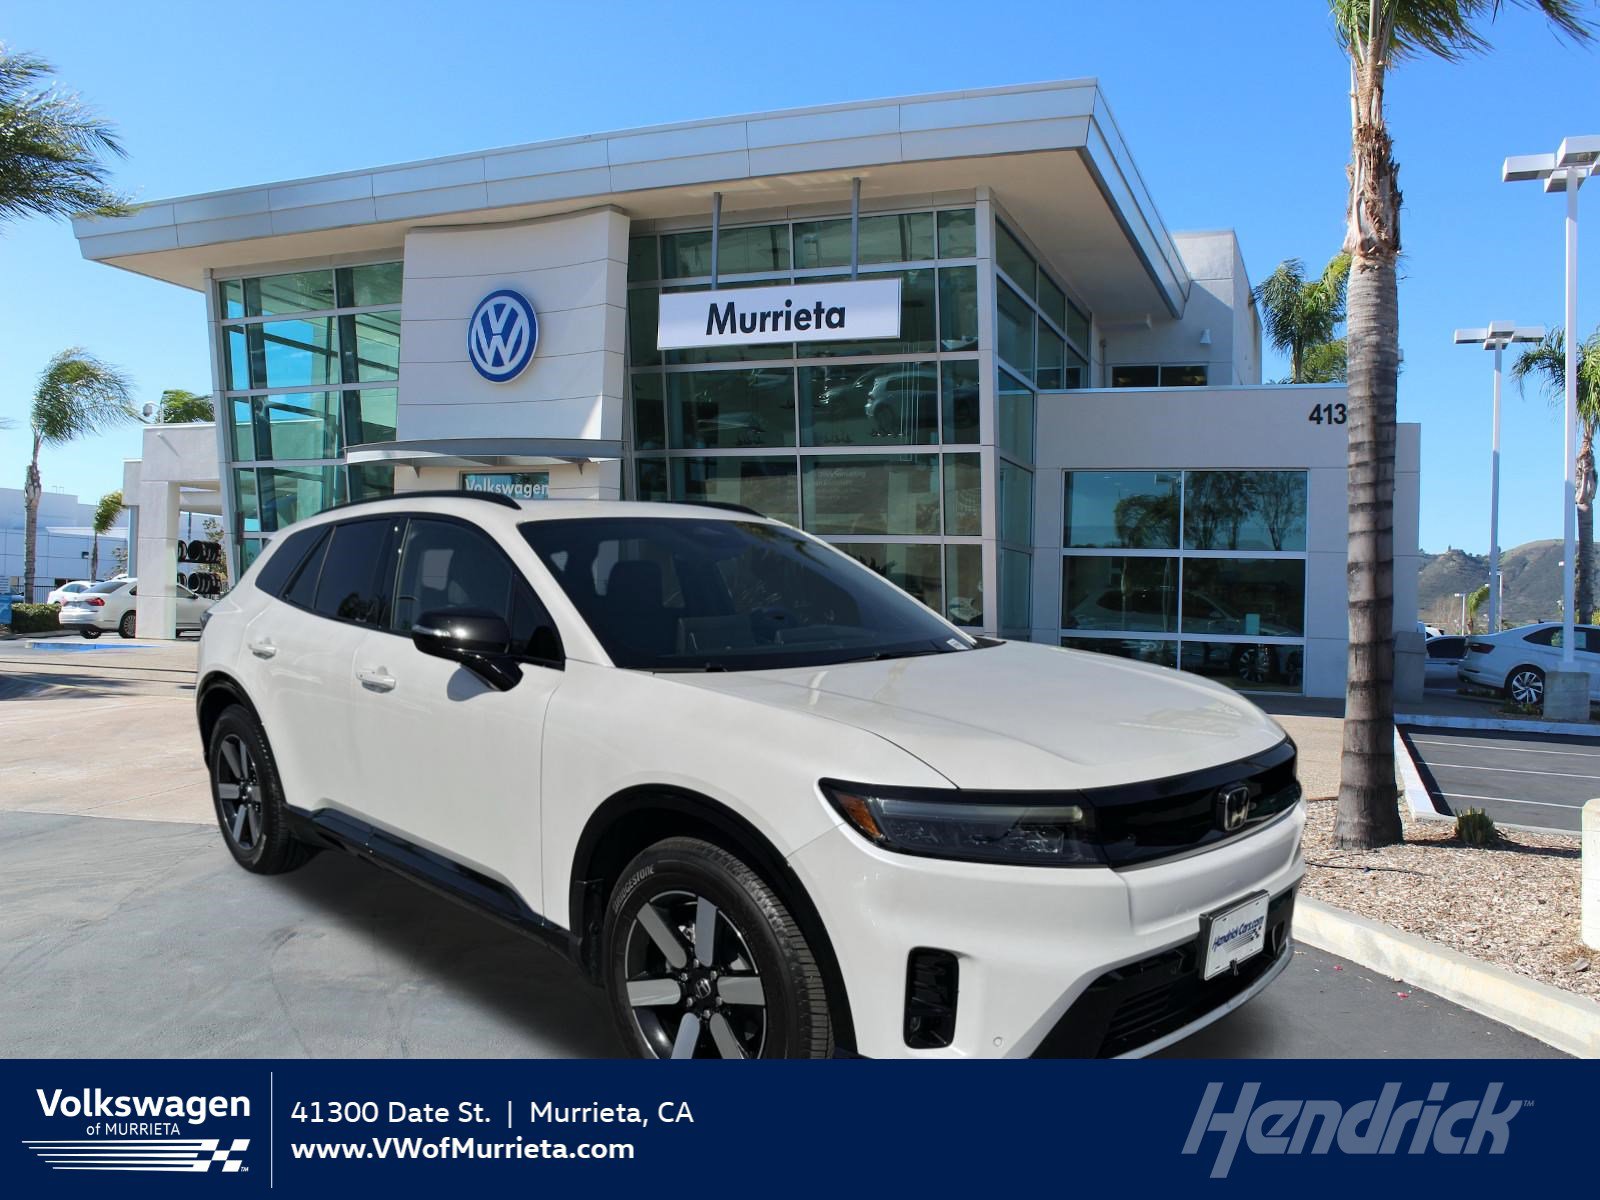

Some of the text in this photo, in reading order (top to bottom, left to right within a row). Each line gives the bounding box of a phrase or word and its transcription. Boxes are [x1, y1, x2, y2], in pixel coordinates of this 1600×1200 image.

[706, 299, 846, 336] Murrieta
[1309, 403, 1347, 425] 413
[465, 478, 549, 498] Volkswagen
